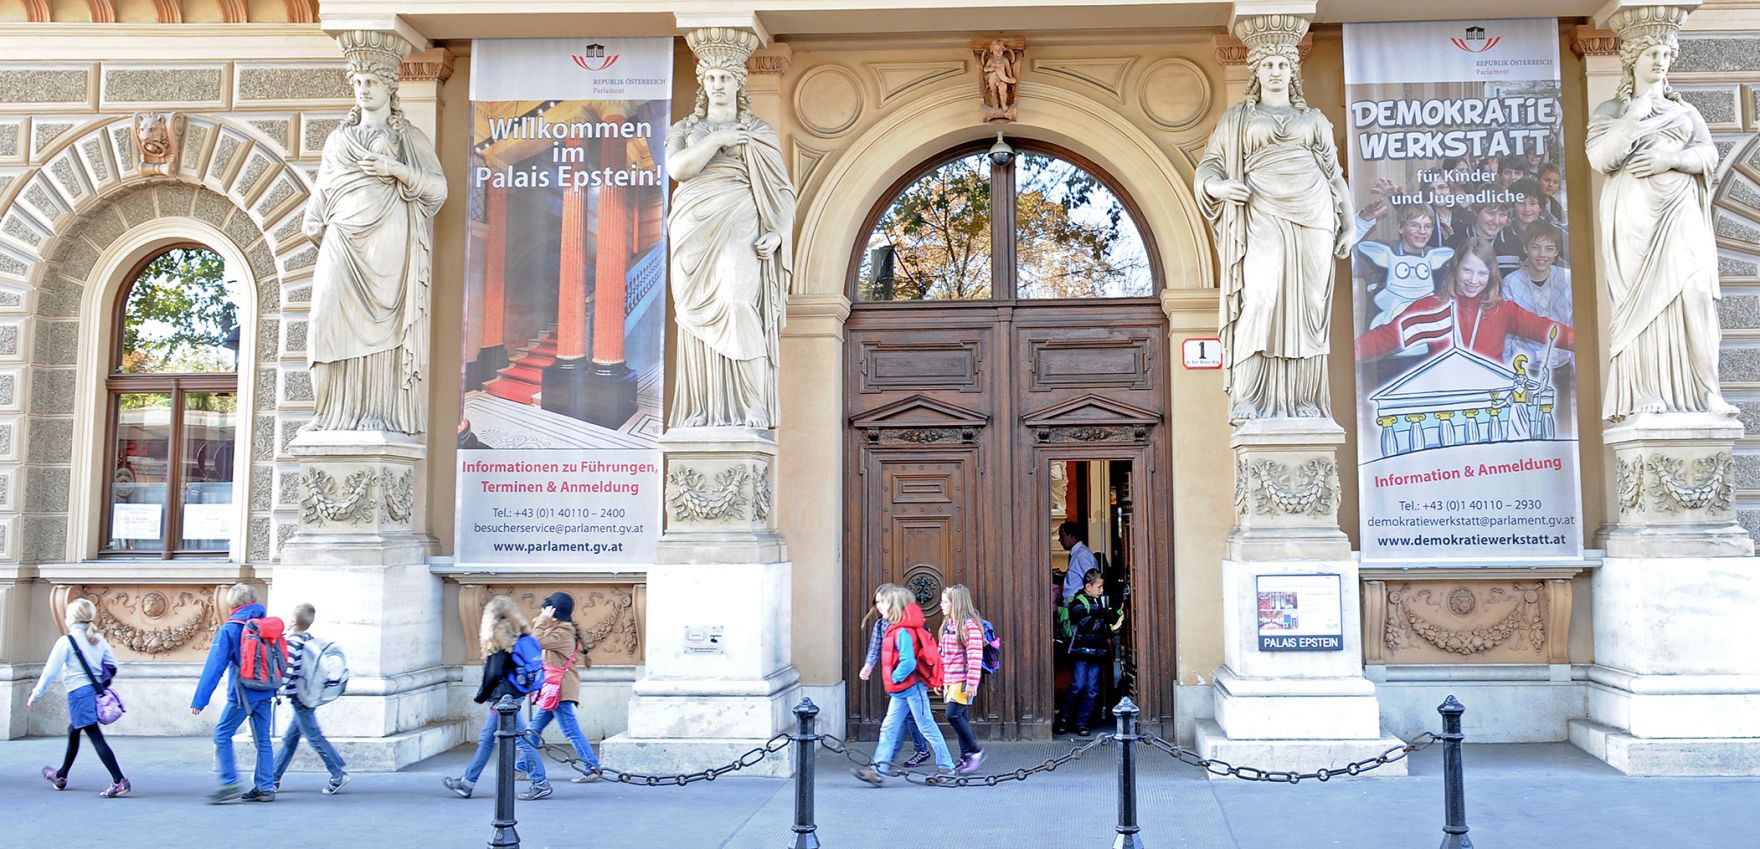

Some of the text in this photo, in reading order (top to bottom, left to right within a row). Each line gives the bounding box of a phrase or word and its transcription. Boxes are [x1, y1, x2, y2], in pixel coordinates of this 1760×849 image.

[488, 116, 652, 140] Willkommen
[1359, 128, 1550, 160] WERKSTATT
[553, 141, 585, 163] im
[475, 163, 662, 193] Palais Epstein!
[1416, 168, 1498, 183] für Kinder
[1391, 189, 1526, 208] und Jugendliche
[1199, 341, 1206, 359] 1
[463, 460, 658, 476] Informationen zu Führungen,
[1375, 457, 1562, 488] Information & Anmeldung
[481, 481, 639, 496] Terminen & Anmeldung
[493, 508, 512, 518] Tel.:
[514, 508, 533, 518] +43
[536, 508, 554, 519] (0)1
[558, 508, 589, 518] 40110
[600, 508, 625, 518] 2400
[1399, 501, 1420, 511] Tel.:
[1422, 501, 1443, 511] +43
[1446, 500, 1465, 512] (0)1
[1469, 500, 1503, 510] 40110
[1515, 500, 1542, 510] 2930
[1368, 515, 1575, 528] demokratiewerkstatt@parlament.gv.at
[474, 523, 644, 536] besucherservice@parlament.gv.at
[493, 541, 623, 554] www.parlament.gv.at
[1378, 534, 1566, 547] www.demokratiewerkstatt.at
[1264, 638, 1338, 648] PALAIS EPSTEIN
